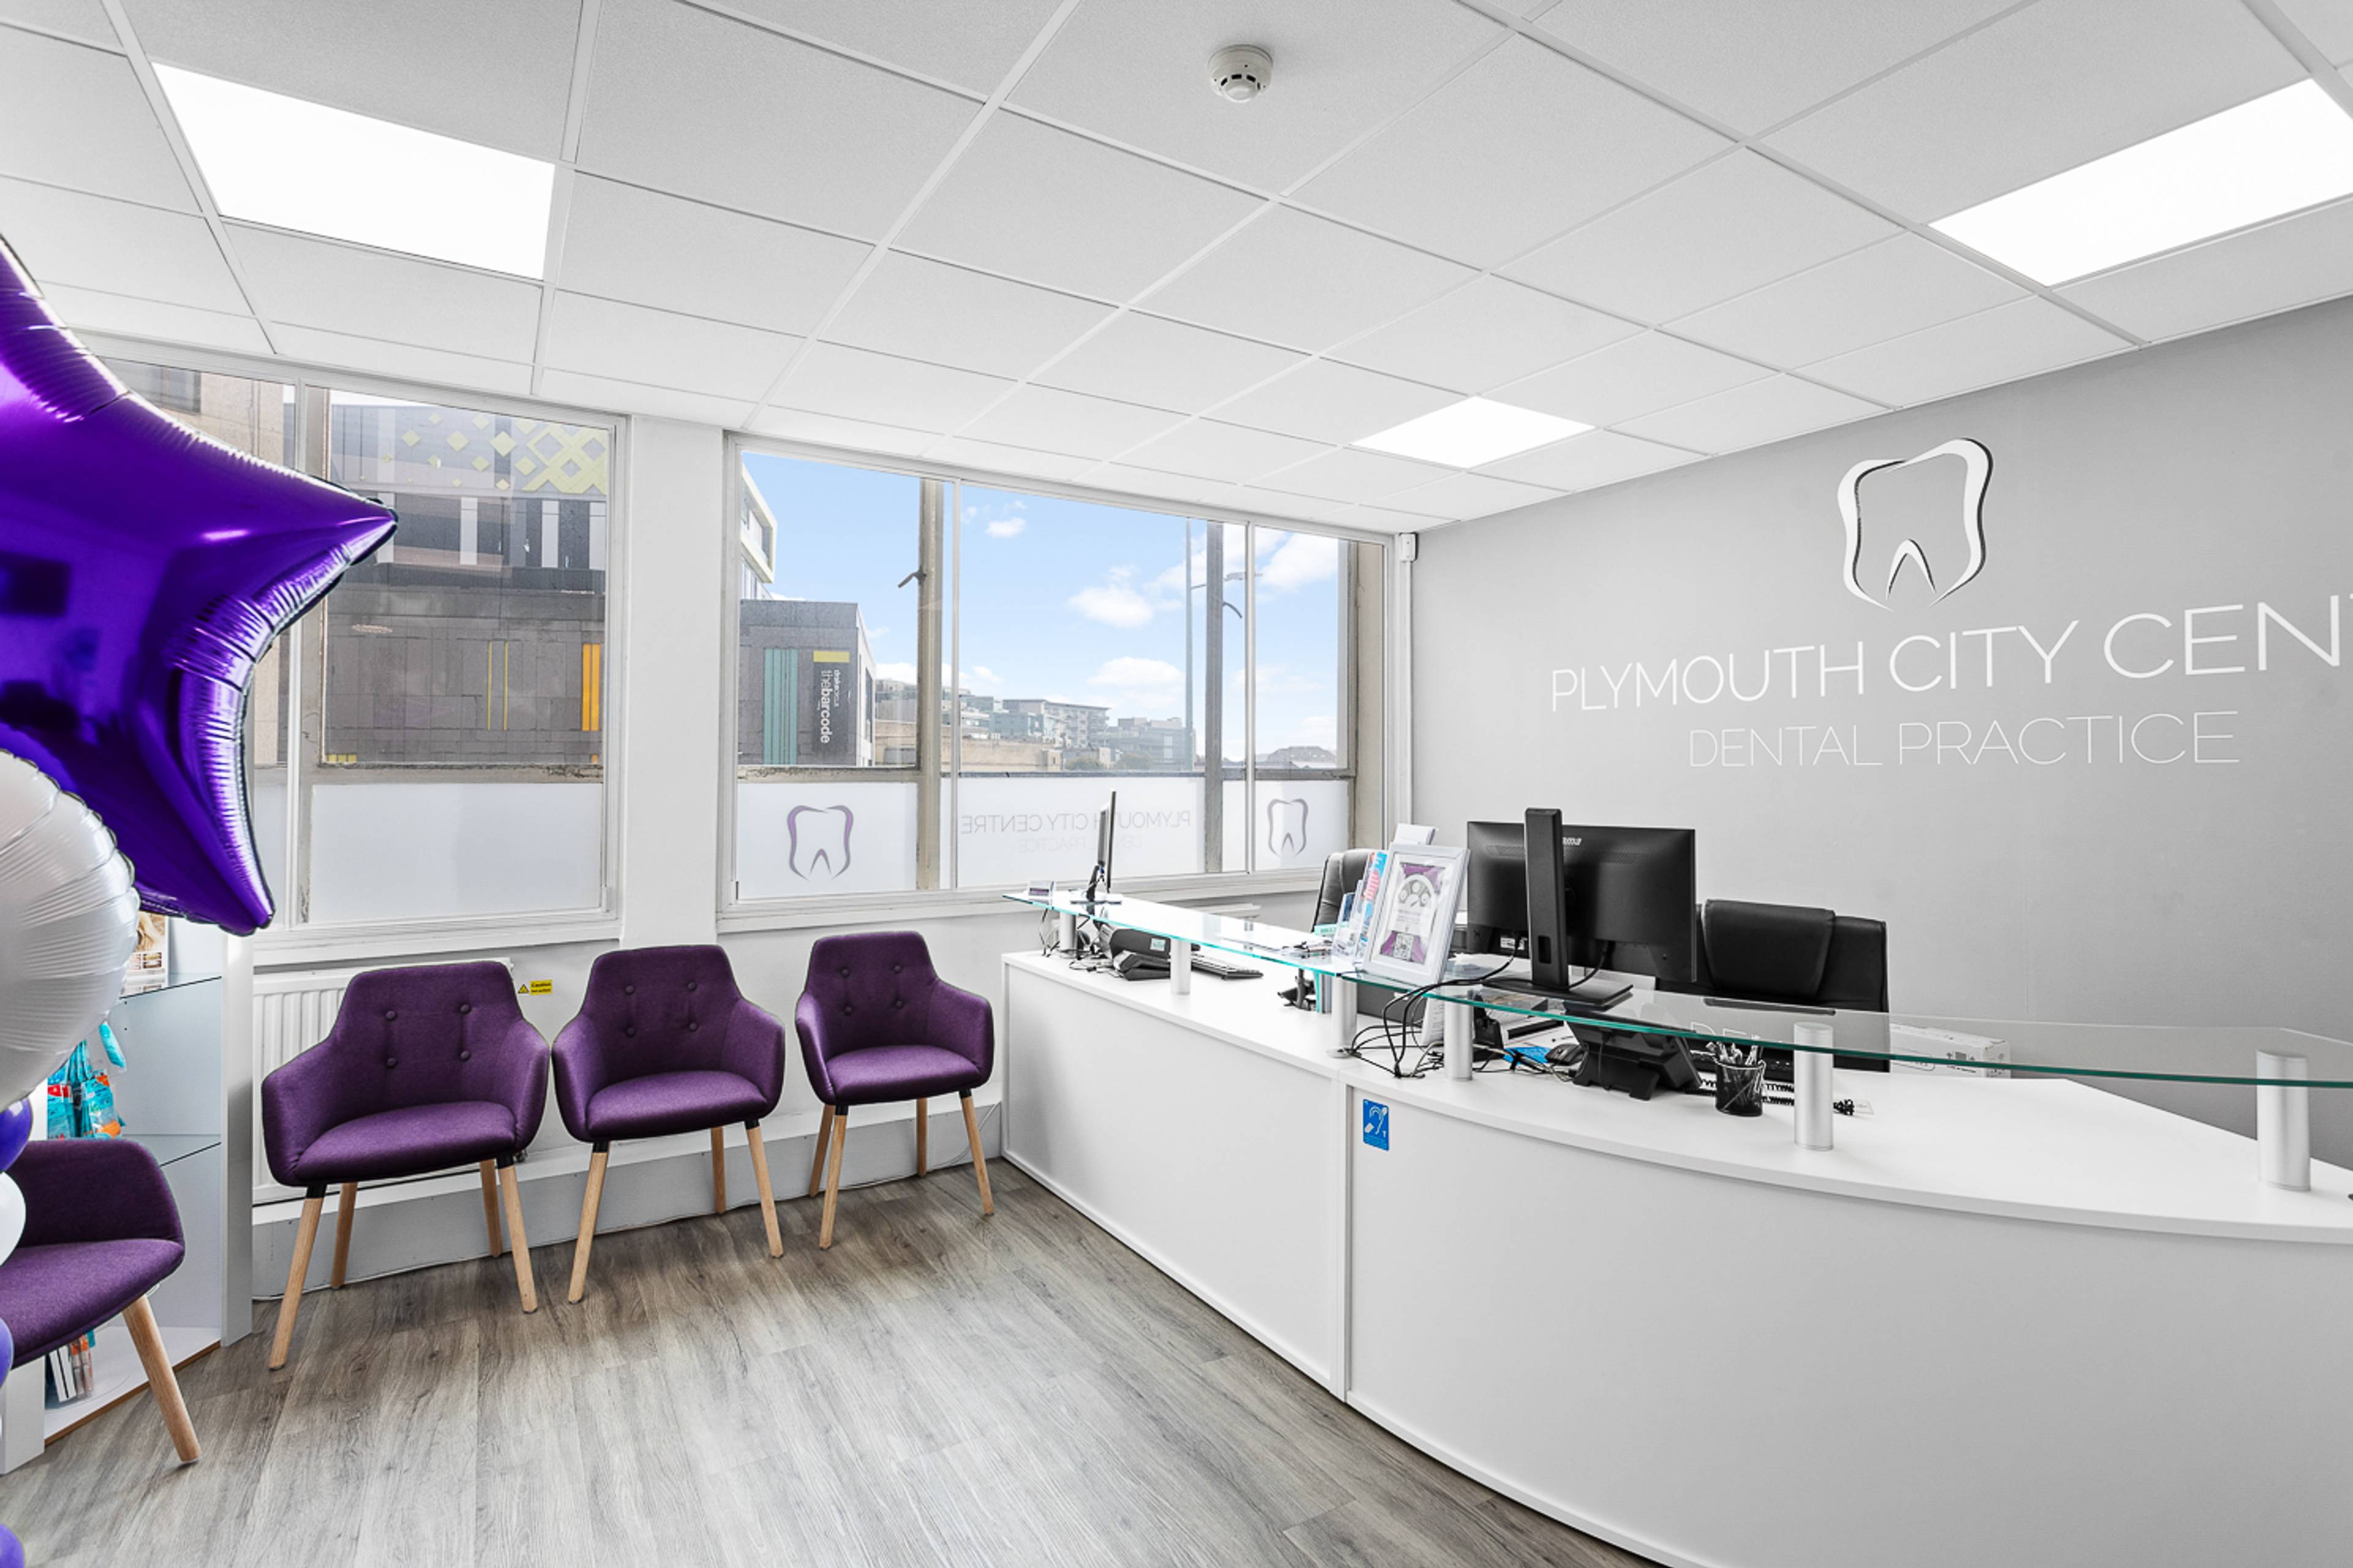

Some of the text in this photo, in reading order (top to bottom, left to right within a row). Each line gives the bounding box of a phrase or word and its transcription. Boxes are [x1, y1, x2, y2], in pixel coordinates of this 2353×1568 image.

[1553, 593, 2353, 711] PLYMOUTH CITY CEN
[1689, 711, 2240, 767] DENTAL PRACTICE
